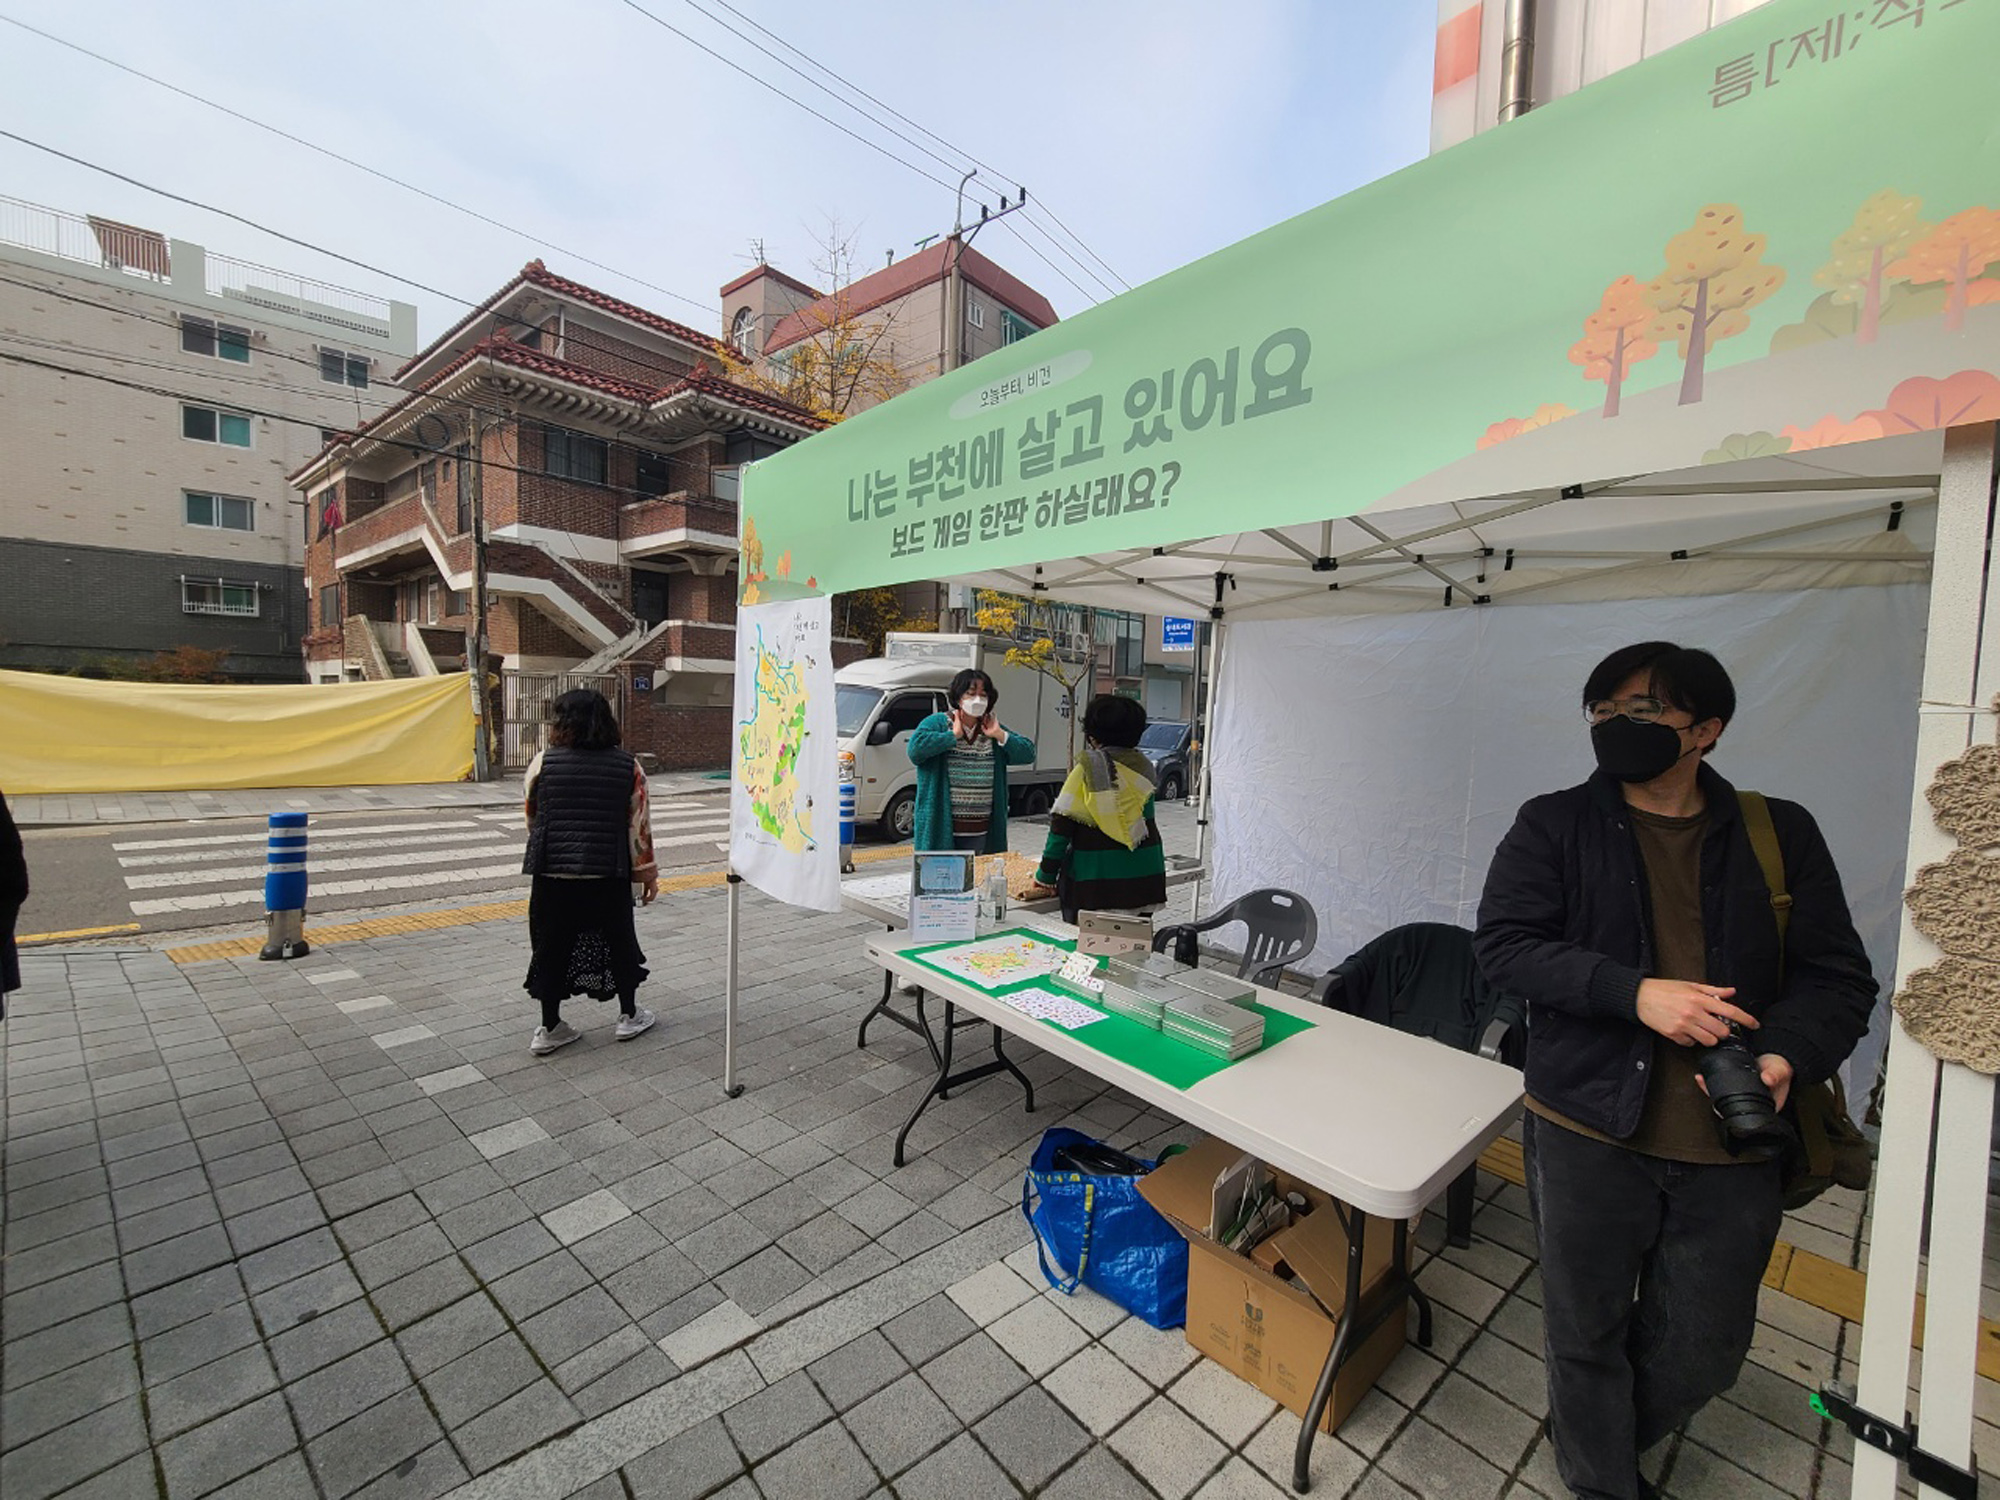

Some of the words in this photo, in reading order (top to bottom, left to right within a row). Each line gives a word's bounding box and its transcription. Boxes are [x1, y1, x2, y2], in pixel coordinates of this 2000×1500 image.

[847, 467, 899, 523] 나는
[905, 427, 1005, 508] 부천에
[1017, 394, 1106, 481] 살고
[1122, 326, 1314, 455] 있어요
[980, 378, 1024, 407] 오늘부터,
[1027, 366, 1051, 388] 비건
[890, 520, 926, 558] 보드
[932, 508, 974, 550] 게임
[979, 495, 1029, 540] 한판
[1034, 460, 1182, 530] 하실래요?
